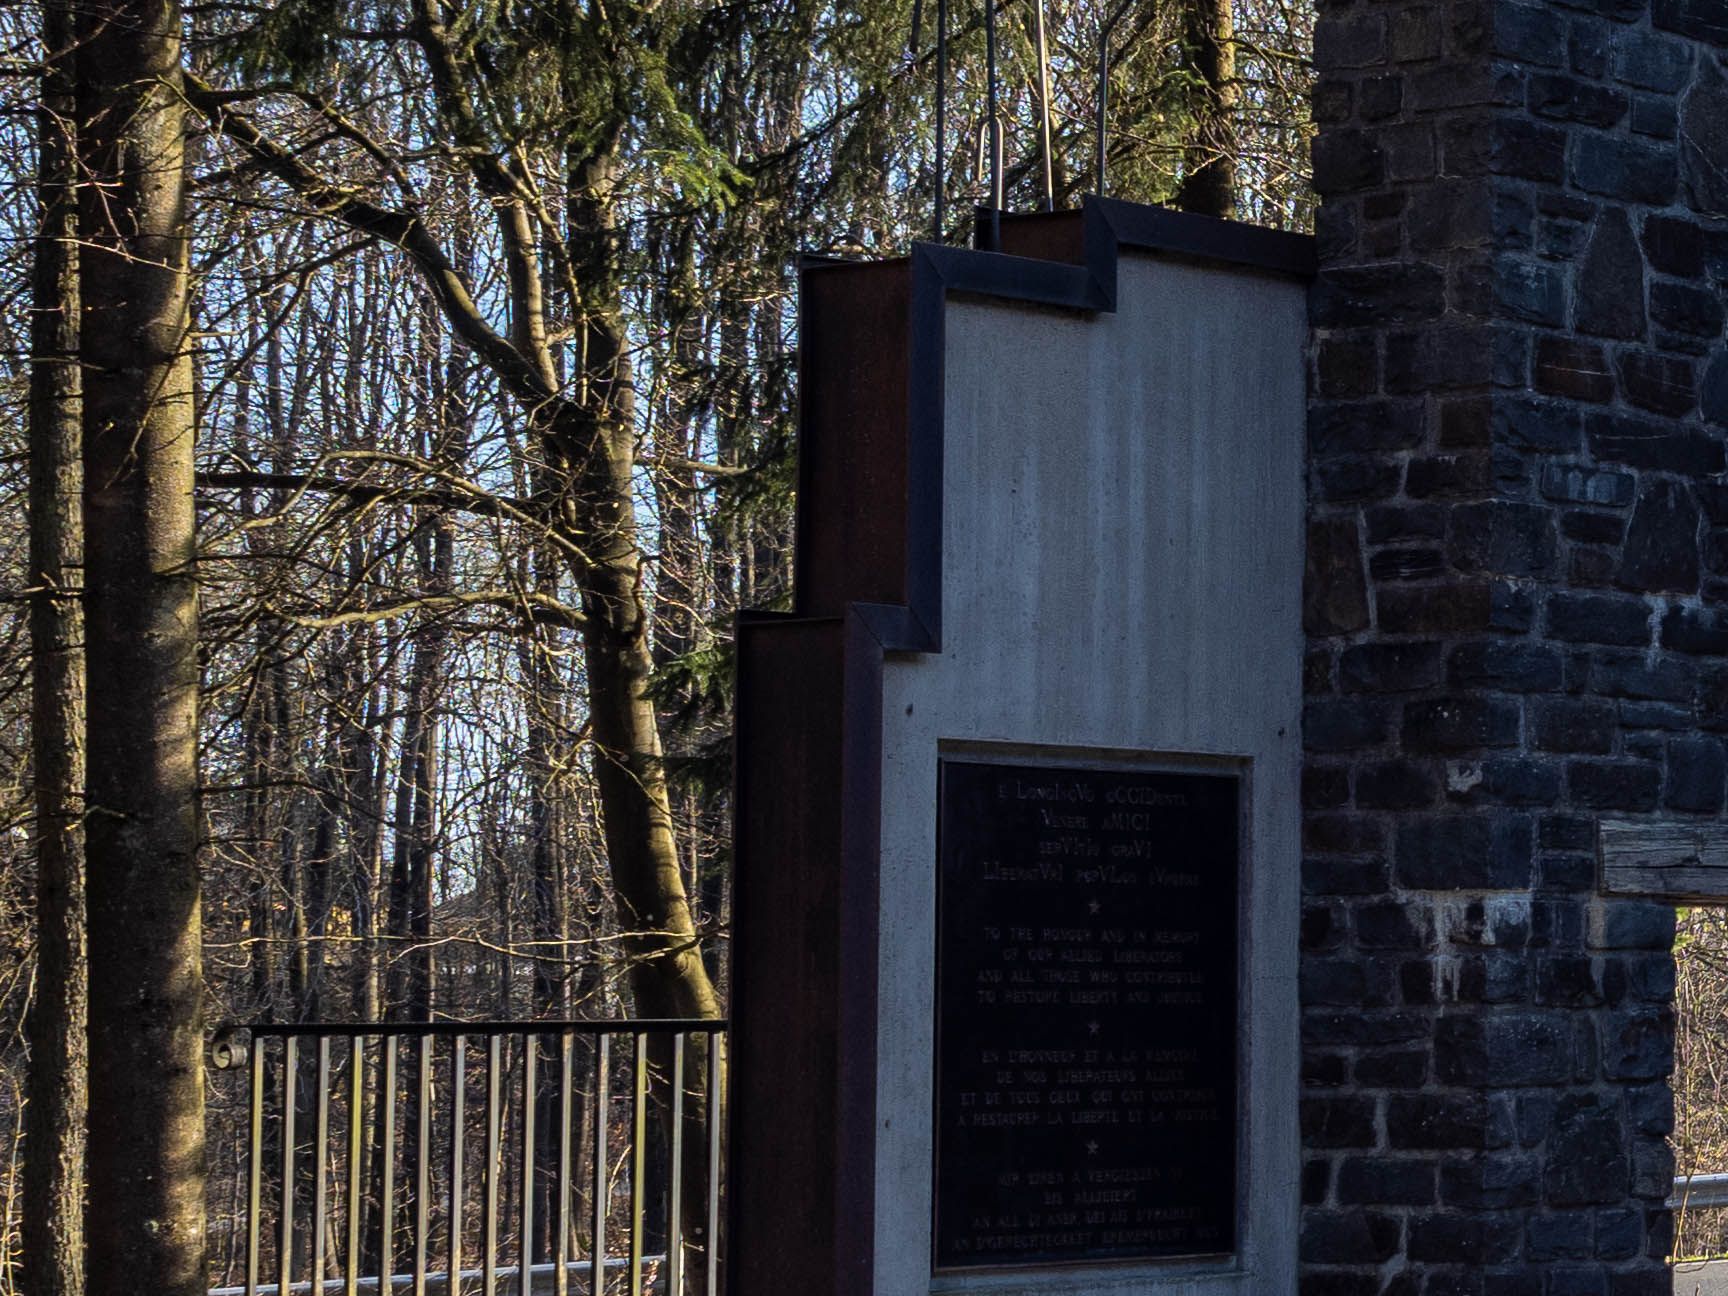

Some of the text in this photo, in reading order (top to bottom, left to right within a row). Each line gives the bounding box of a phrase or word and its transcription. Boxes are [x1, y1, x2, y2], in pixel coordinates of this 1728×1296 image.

[984, 927, 1000, 943] TO
[1010, 927, 1033, 942] THE
[1100, 928, 1127, 944] AND
[1028, 948, 1053, 961] OUR
[1061, 948, 1103, 963] ALLIED
[1113, 950, 1183, 964] LIBERATORS
[976, 969, 1003, 984] AND
[1010, 969, 1034, 984] ALL
[1041, 969, 1080, 983] THOSE
[1089, 970, 1118, 984] WHO
[976, 990, 996, 1004] TO
[1005, 991, 1060, 1004] RESTORE
[1069, 991, 1118, 1005] LIBERTY
[1128, 992, 1151, 1004] AND
[982, 1050, 1000, 1064] EN
[997, 1071, 1014, 1084] DE
[1024, 1071, 1047, 1083] NOS
[960, 1092, 976, 1106] ET
[984, 1091, 1000, 1105] DE
[1008, 1091, 1040, 1104] TOUS
[1049, 1090, 1081, 1105] CEUX
[1091, 1090, 1112, 1104] QUI
[1120, 1089, 1144, 1103] ONT
[974, 1111, 1040, 1126] RESTAURER
[1048, 1111, 1064, 1125] LA
